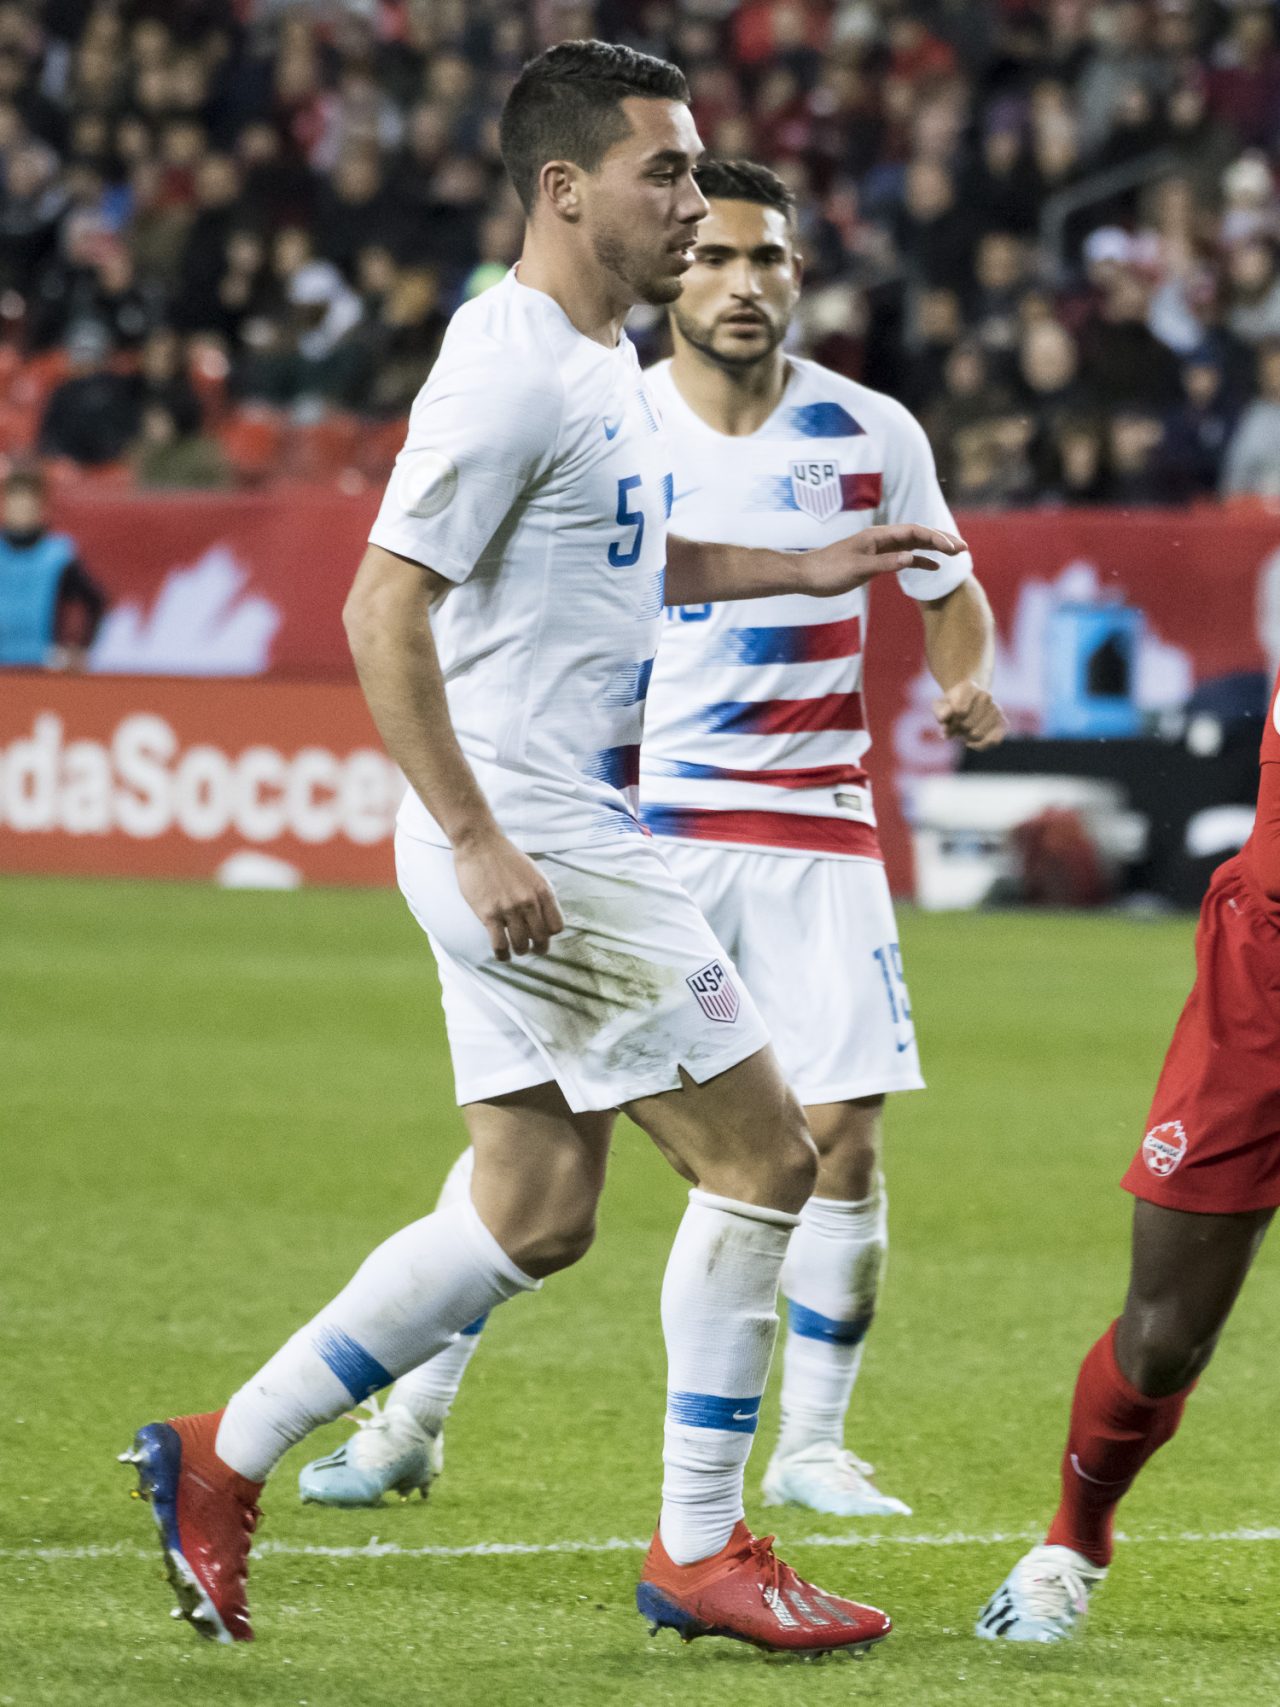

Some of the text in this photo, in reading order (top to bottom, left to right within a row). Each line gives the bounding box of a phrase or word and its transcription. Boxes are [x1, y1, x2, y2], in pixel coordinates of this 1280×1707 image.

[793, 464, 834, 486] USA
[607, 474, 645, 568] 5
[0, 712, 401, 845] daSocce
[691, 964, 724, 992] USA
